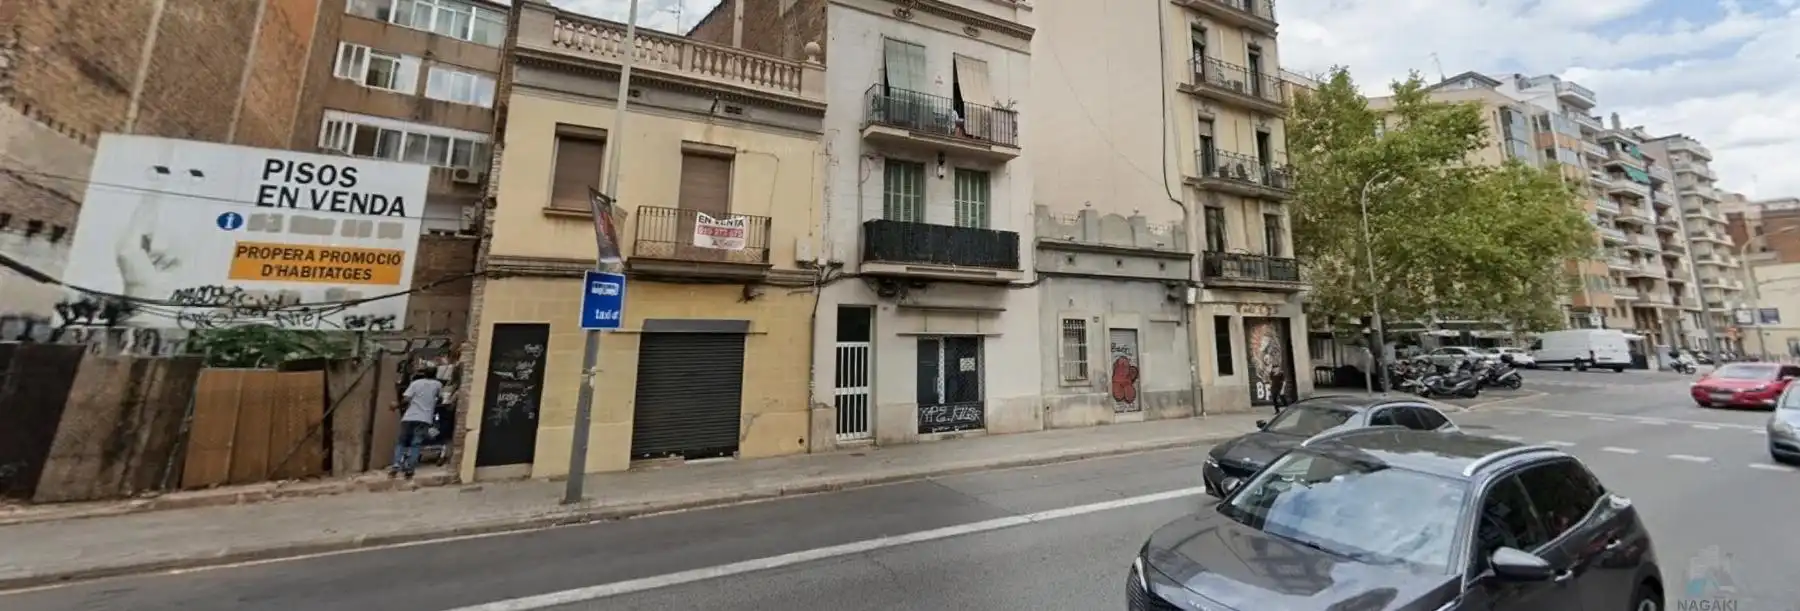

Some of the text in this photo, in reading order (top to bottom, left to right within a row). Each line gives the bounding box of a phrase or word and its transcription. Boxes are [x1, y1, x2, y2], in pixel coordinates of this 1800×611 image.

[262, 158, 358, 188] PISOS
[256, 184, 406, 217] EN VENDA
[699, 215, 711, 224] EN
[235, 245, 315, 262] PROPERA
[261, 264, 373, 281] D'HABITATGES
